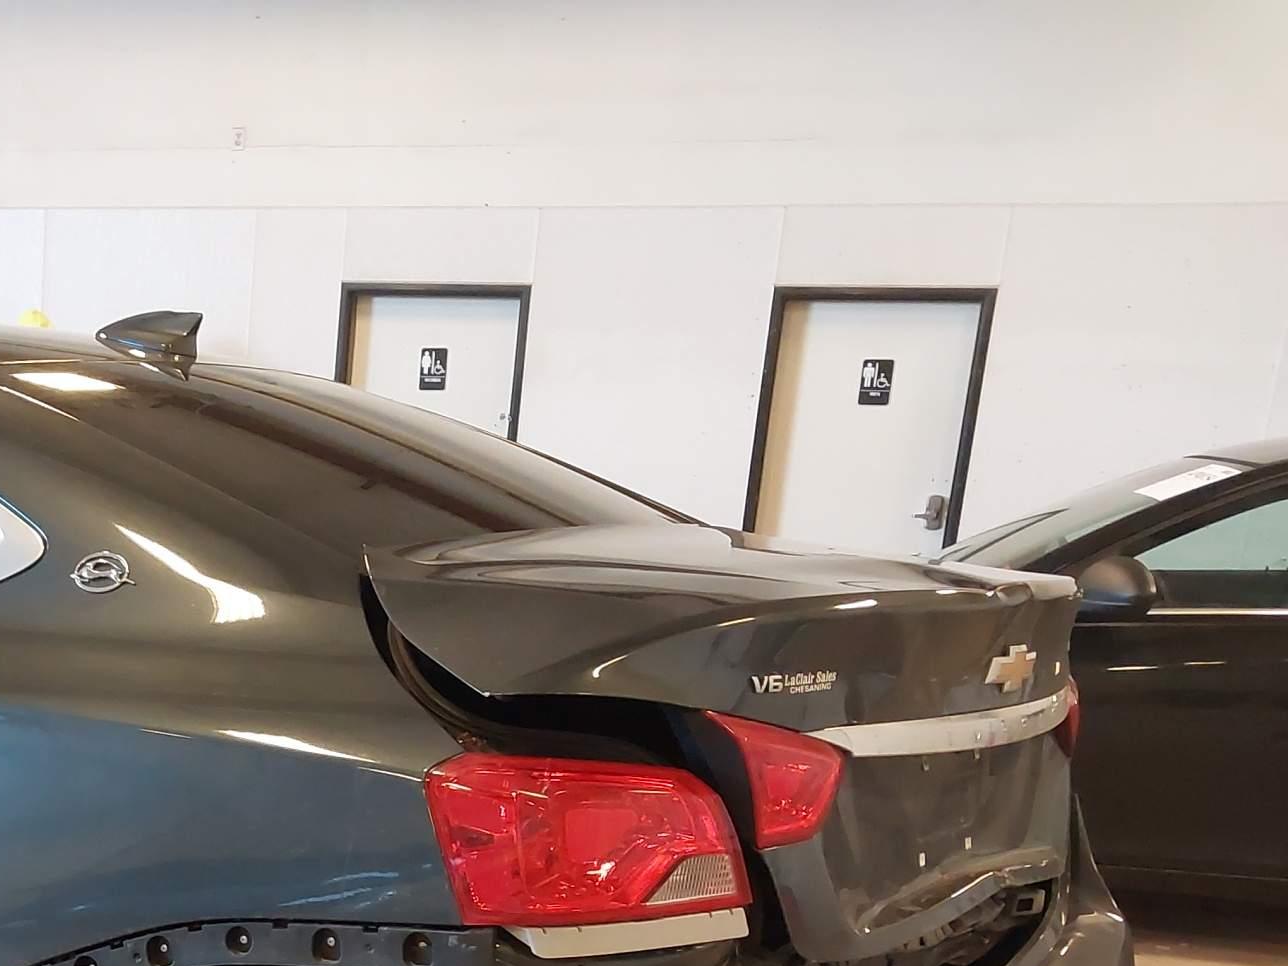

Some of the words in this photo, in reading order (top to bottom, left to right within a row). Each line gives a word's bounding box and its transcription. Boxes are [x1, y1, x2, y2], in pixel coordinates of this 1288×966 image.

[751, 675, 783, 694] V6
[784, 673, 815, 687] LaClair
[816, 671, 837, 683] Sales
[790, 683, 832, 694] CHESANING
